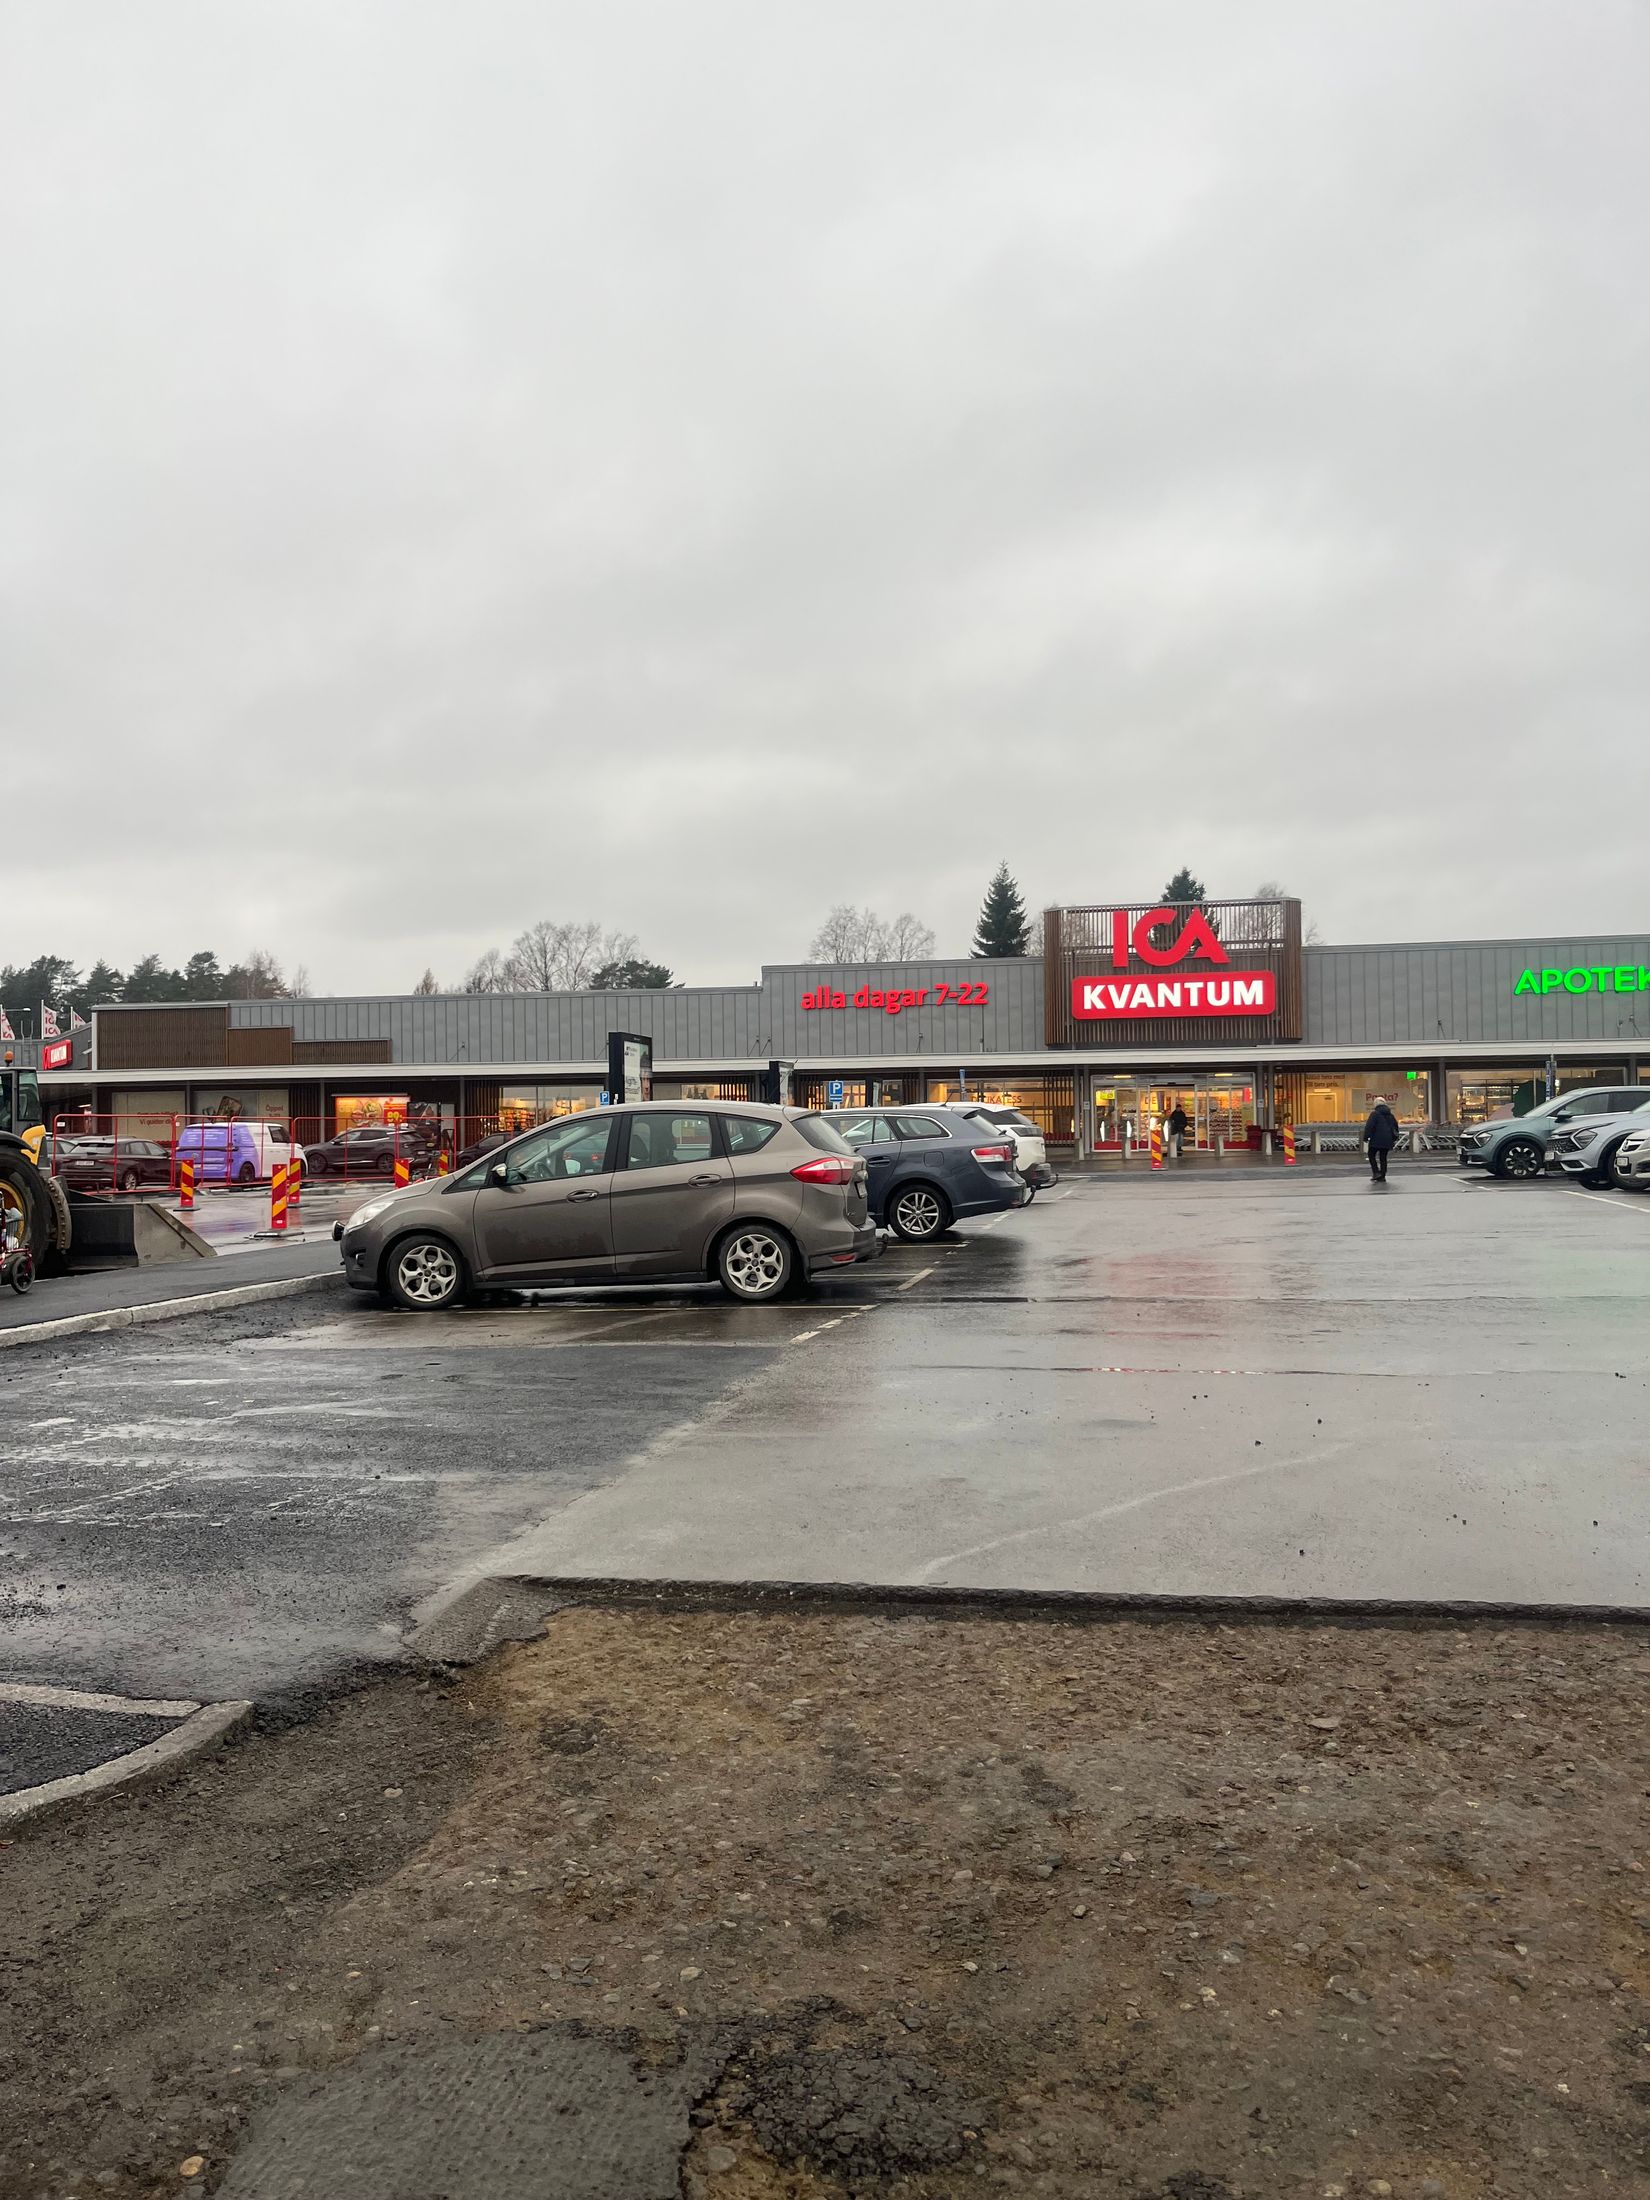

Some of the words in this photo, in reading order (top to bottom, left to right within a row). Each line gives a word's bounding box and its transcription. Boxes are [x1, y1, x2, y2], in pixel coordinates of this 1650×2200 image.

[1112, 907, 1230, 967] ICA
[801, 985, 846, 1009] alla
[853, 983, 929, 1014] dagar
[934, 981, 989, 1006] 7-22
[1083, 979, 1264, 1010] KVANTUM
[601, 1093, 608, 1102] P
[833, 1082, 841, 1094] P
[1365, 1093, 1399, 1103] Pata?
